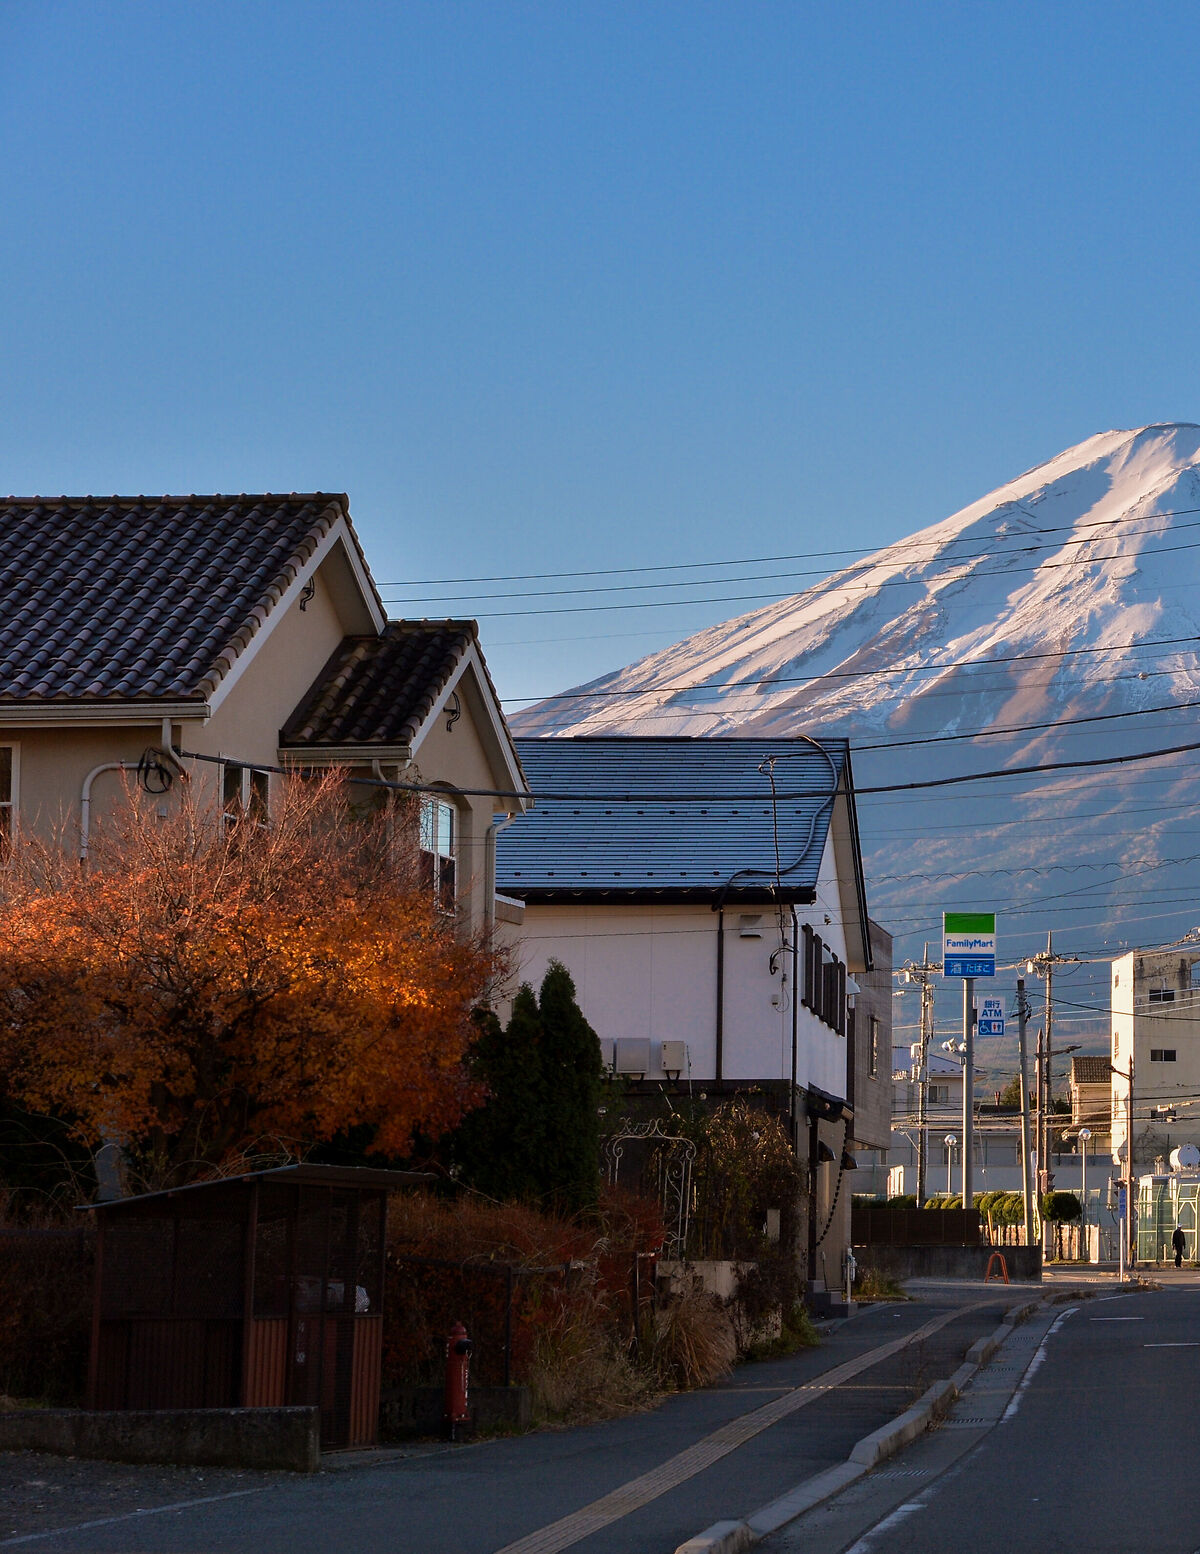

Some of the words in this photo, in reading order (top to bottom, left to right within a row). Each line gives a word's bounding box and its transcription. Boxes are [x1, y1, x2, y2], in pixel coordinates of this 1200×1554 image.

[946, 939, 993, 950] FamilyMart
[985, 1000, 1000, 1008] 銀行
[982, 1009, 1002, 1017] ATM
